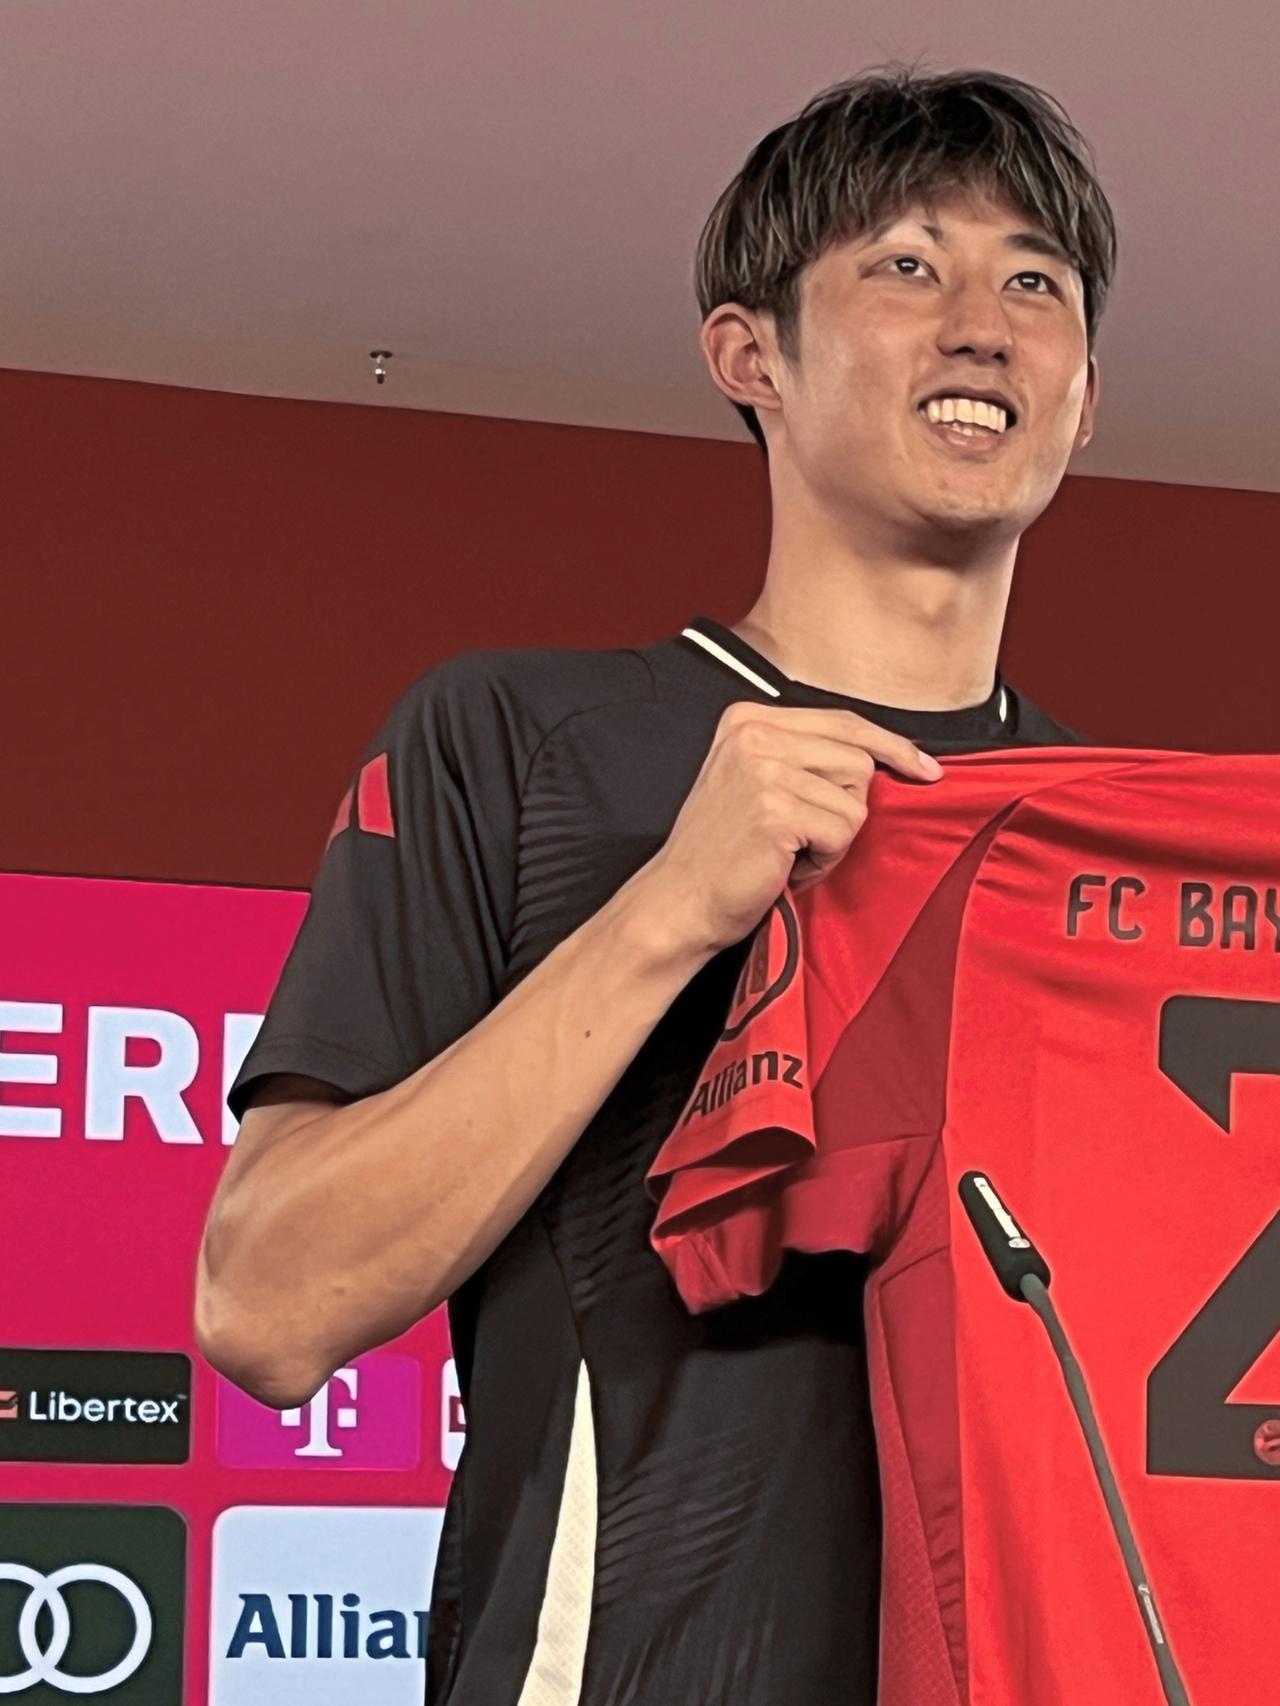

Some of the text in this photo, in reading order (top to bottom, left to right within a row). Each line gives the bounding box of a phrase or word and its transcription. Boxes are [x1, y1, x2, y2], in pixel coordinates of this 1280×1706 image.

[1066, 874, 1147, 941] FC
[683, 1050, 804, 1126] Allianz
[29, 1391, 178, 1423] Libertex
